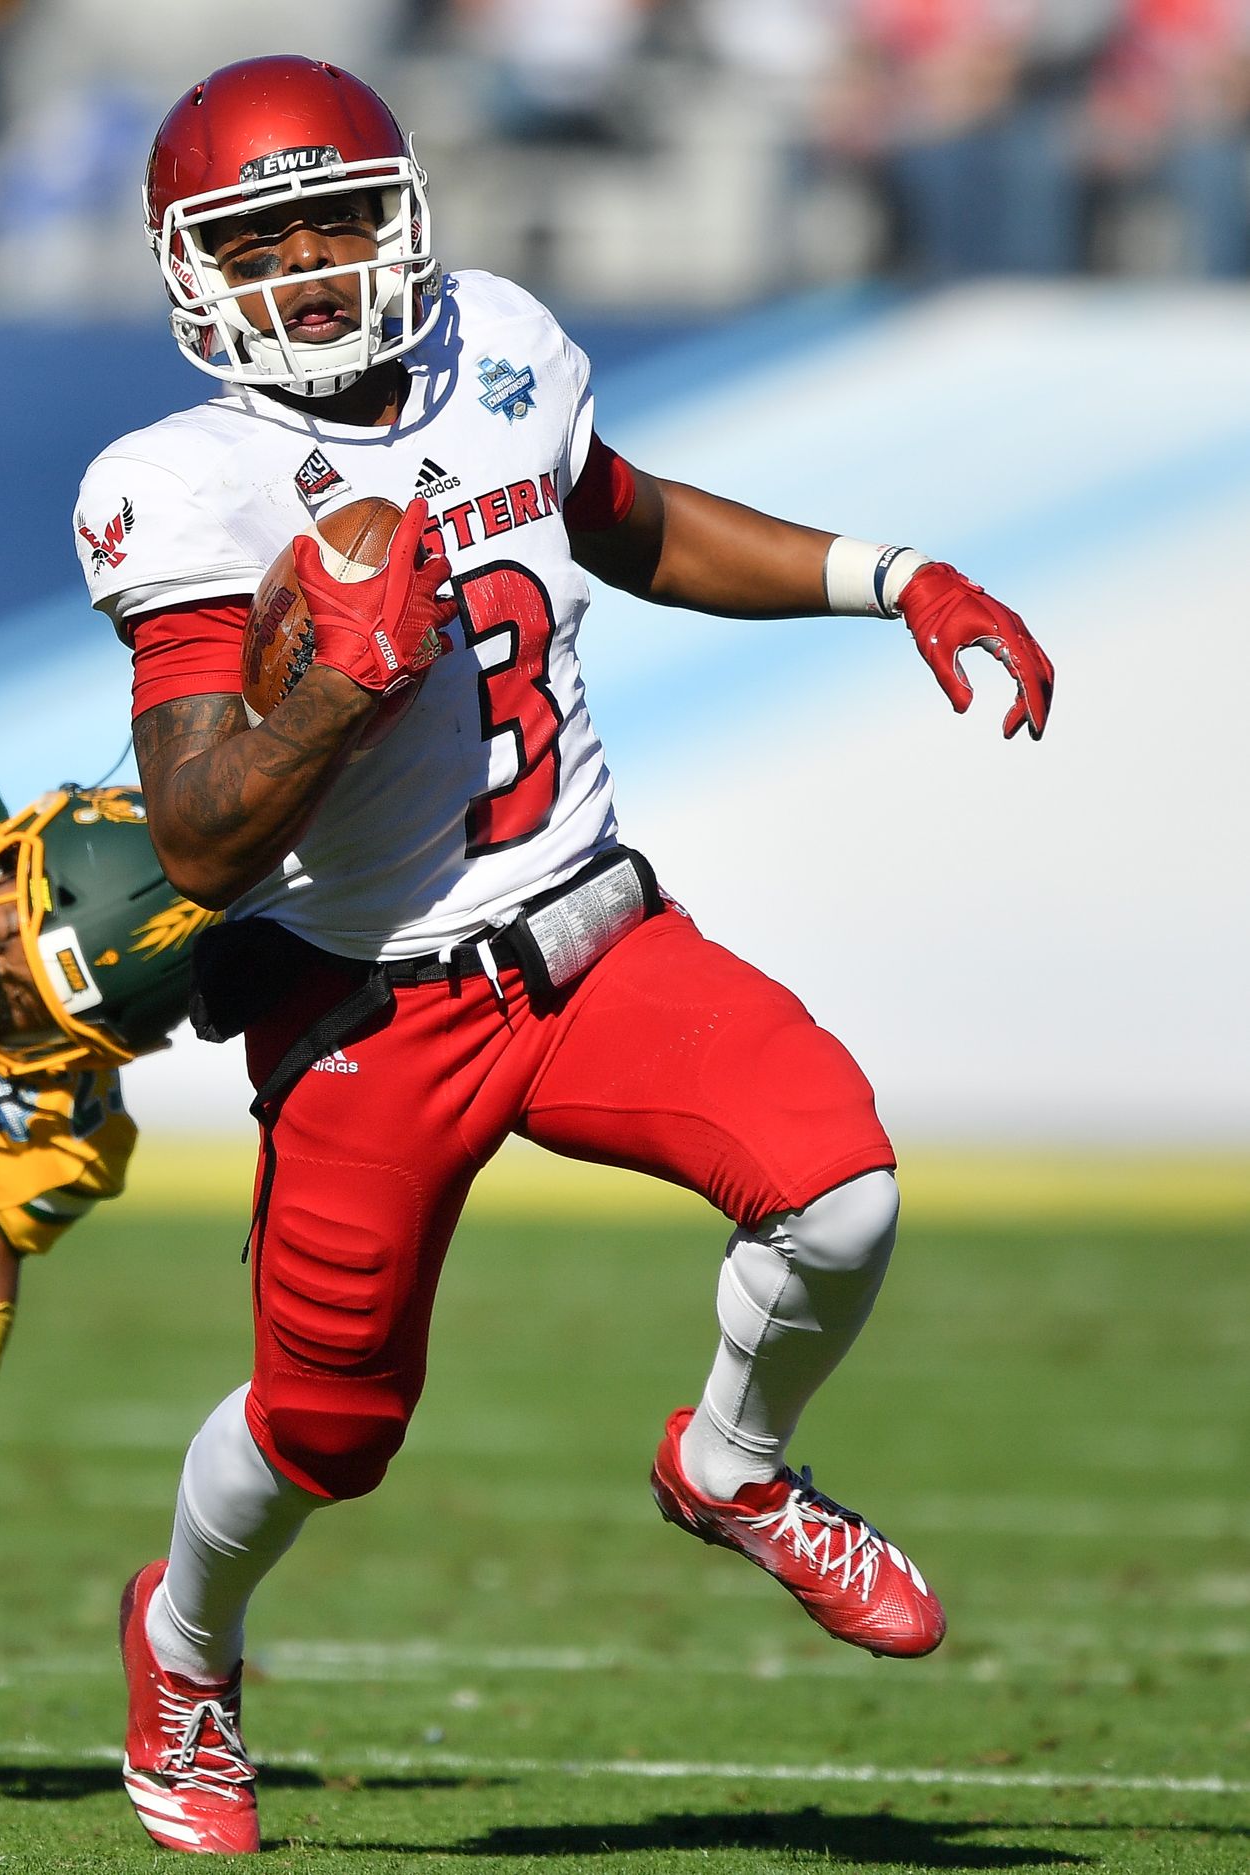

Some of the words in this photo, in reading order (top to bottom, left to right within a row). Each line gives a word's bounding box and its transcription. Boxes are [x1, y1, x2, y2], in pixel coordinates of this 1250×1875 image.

[263, 147, 318, 176] EWU
[299, 451, 331, 487] SKY
[453, 558, 562, 860] 3
